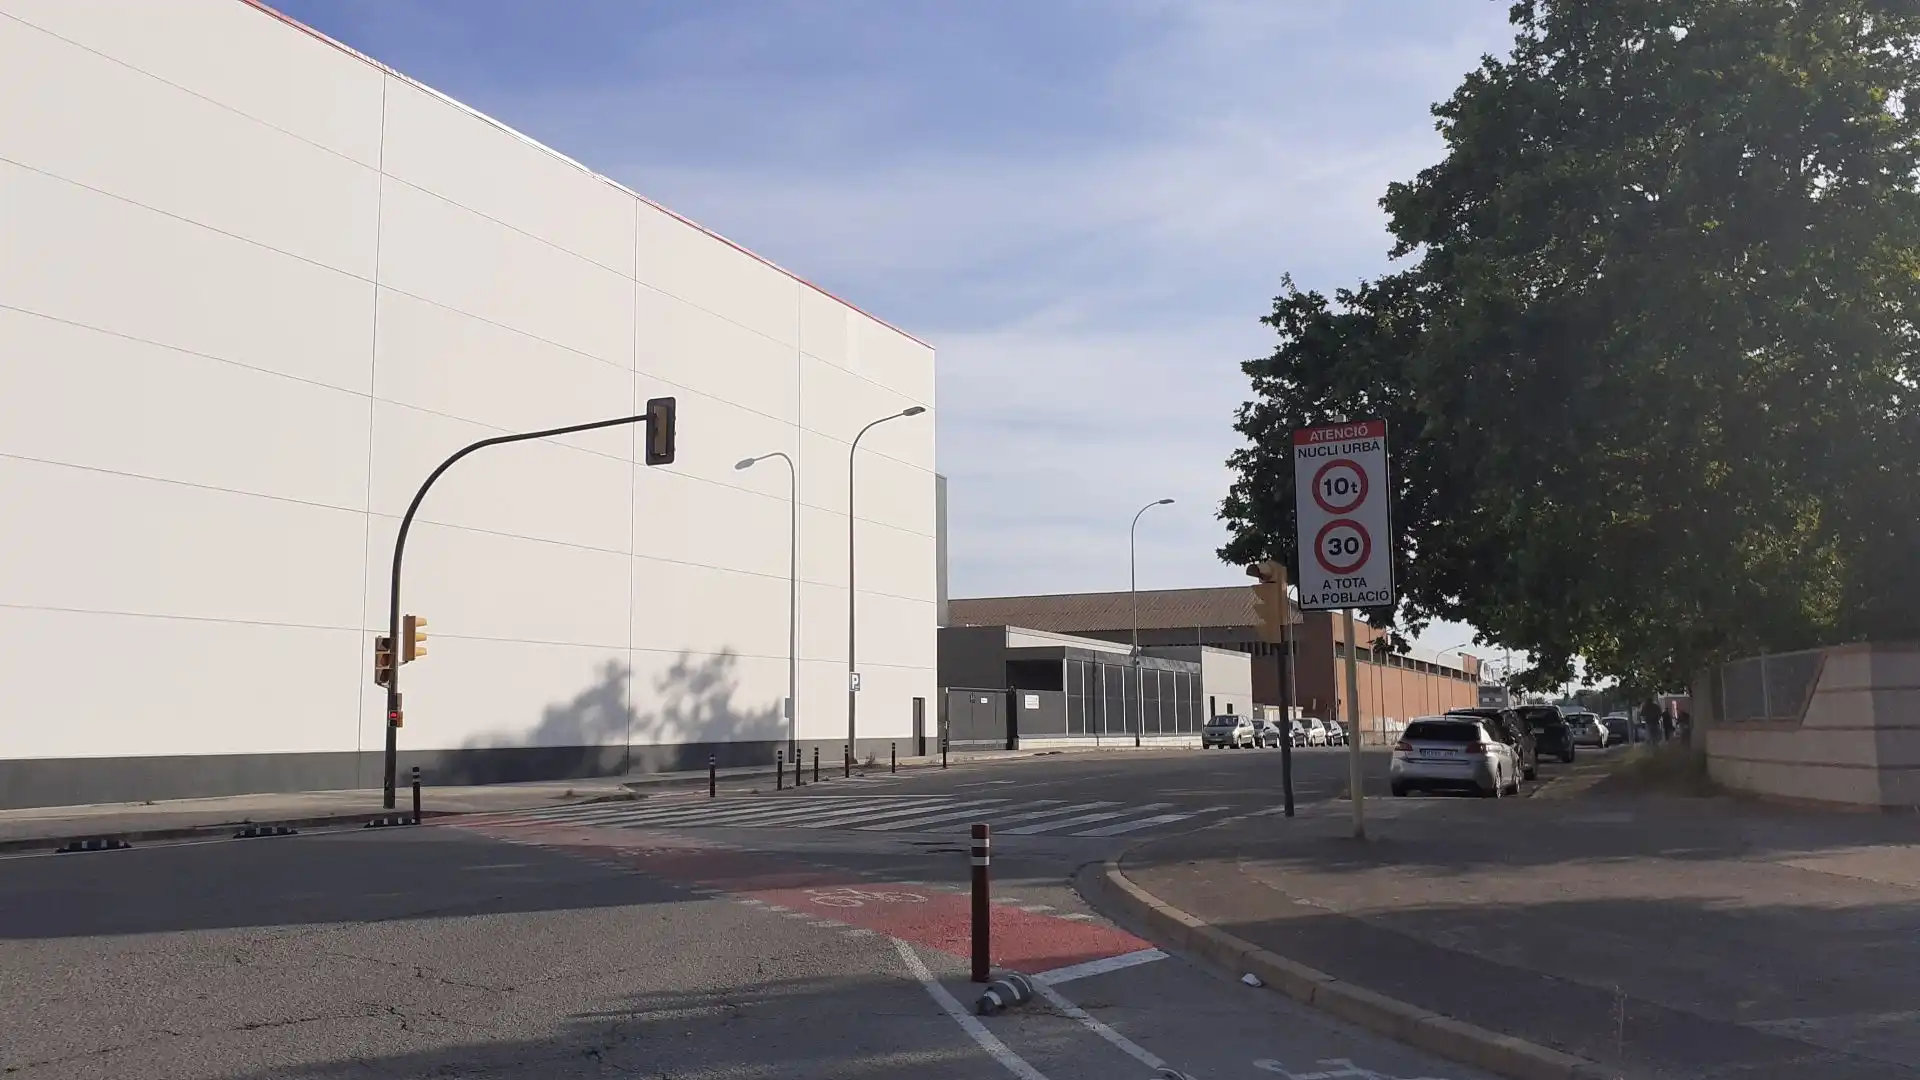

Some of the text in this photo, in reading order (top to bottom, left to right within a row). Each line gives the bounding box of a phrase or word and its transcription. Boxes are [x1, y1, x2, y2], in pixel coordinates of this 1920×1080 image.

[1310, 423, 1368, 442] ATENCIÓ
[1298, 444, 1338, 458] NUCLI
[1328, 537, 1359, 556] 30
[1323, 577, 1367, 590] A TOTA
[1302, 586, 1389, 605] LA POBLACIÓ
